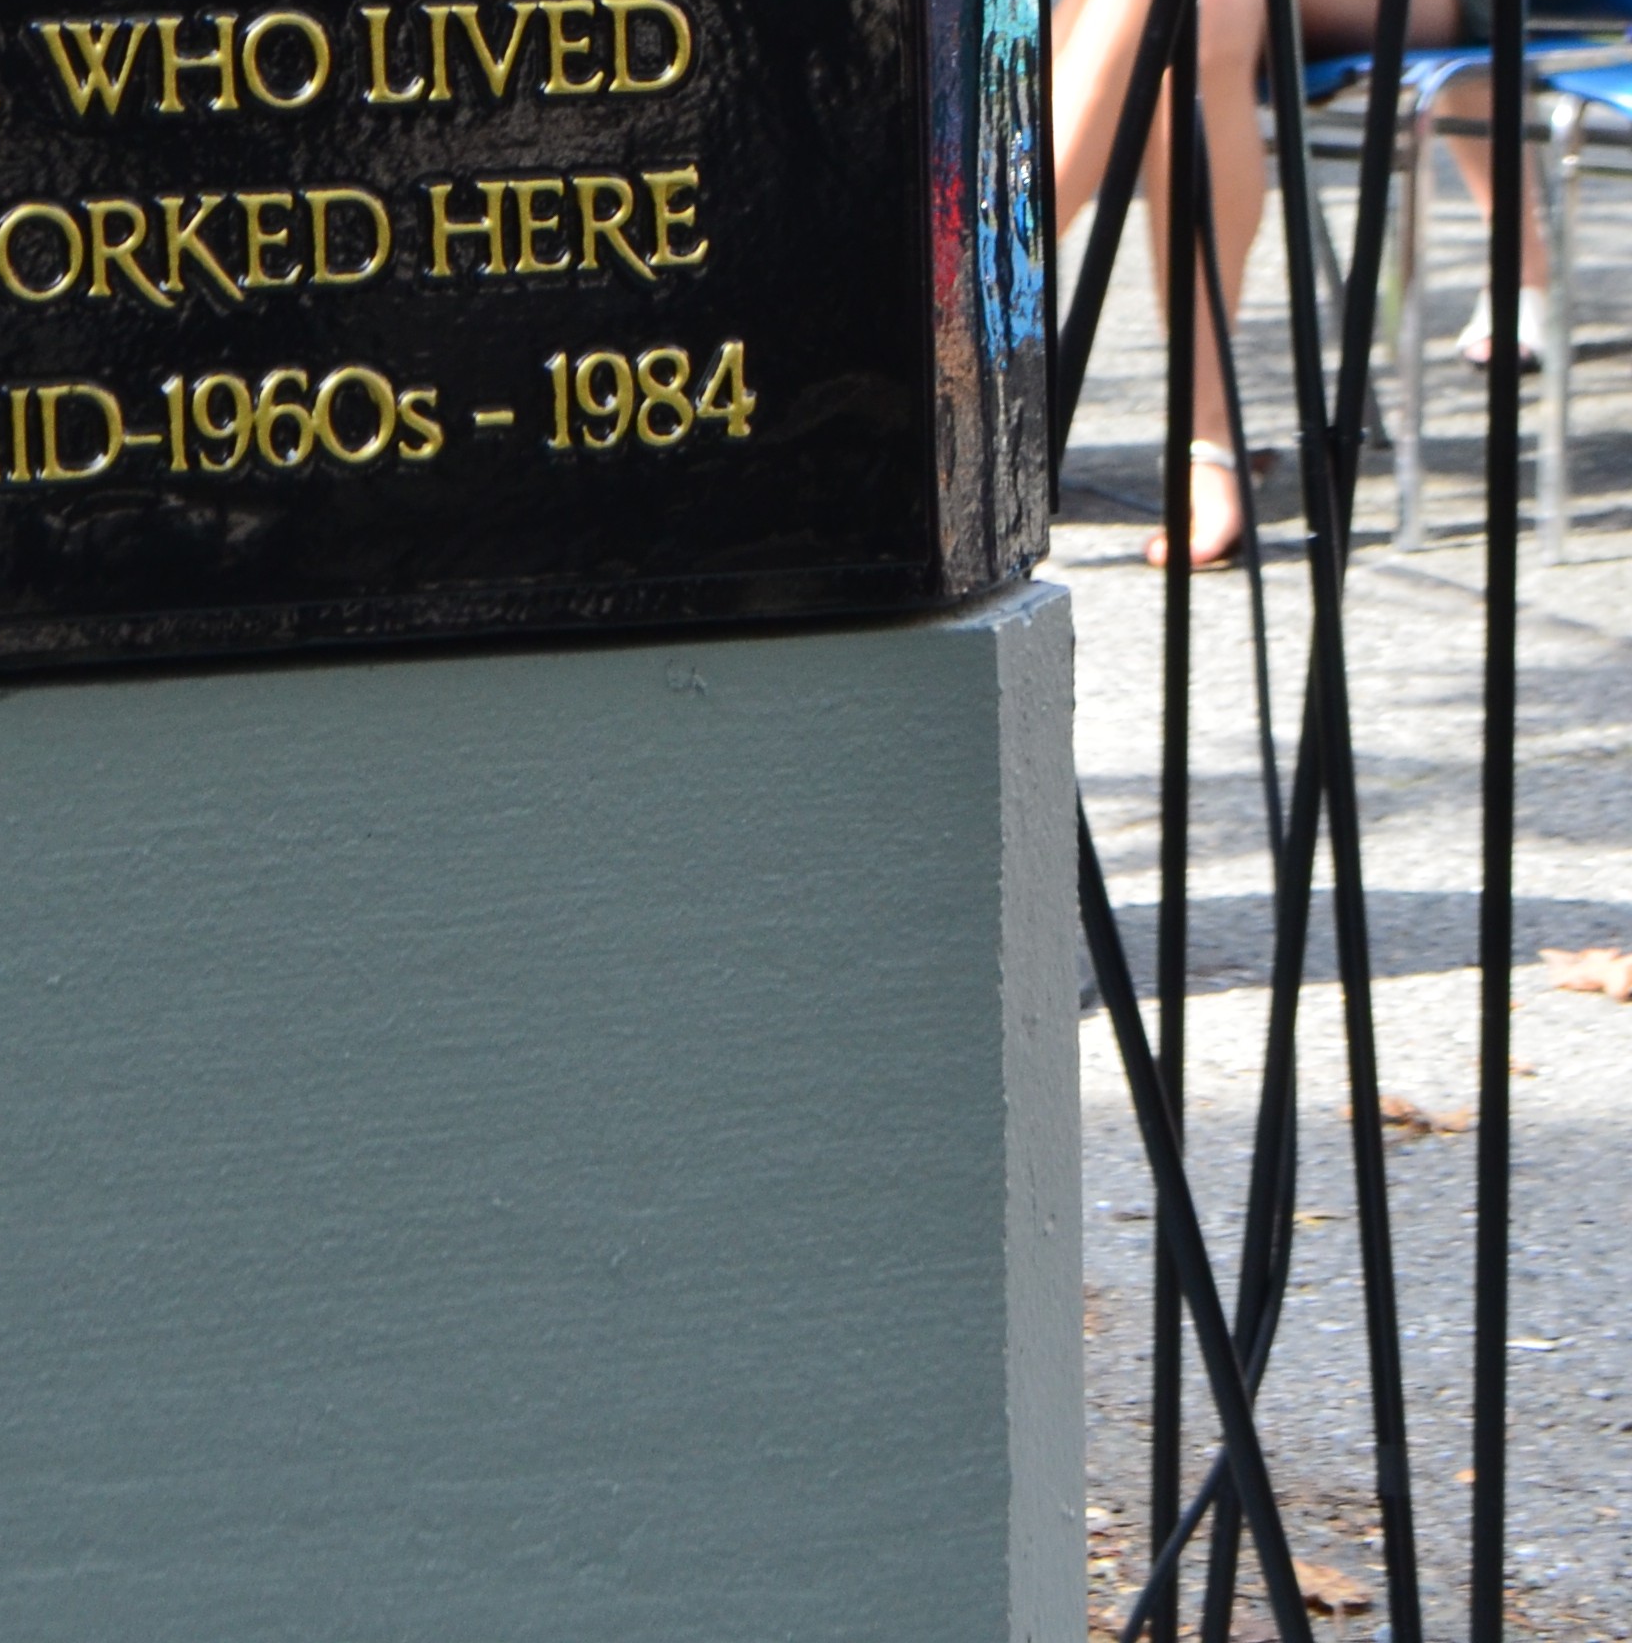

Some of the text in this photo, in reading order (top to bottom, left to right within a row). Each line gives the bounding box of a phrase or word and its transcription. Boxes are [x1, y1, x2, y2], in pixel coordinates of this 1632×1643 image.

[40, 9, 333, 116] WHO
[428, 161, 711, 282] HERE
[550, 338, 758, 451] 1984
